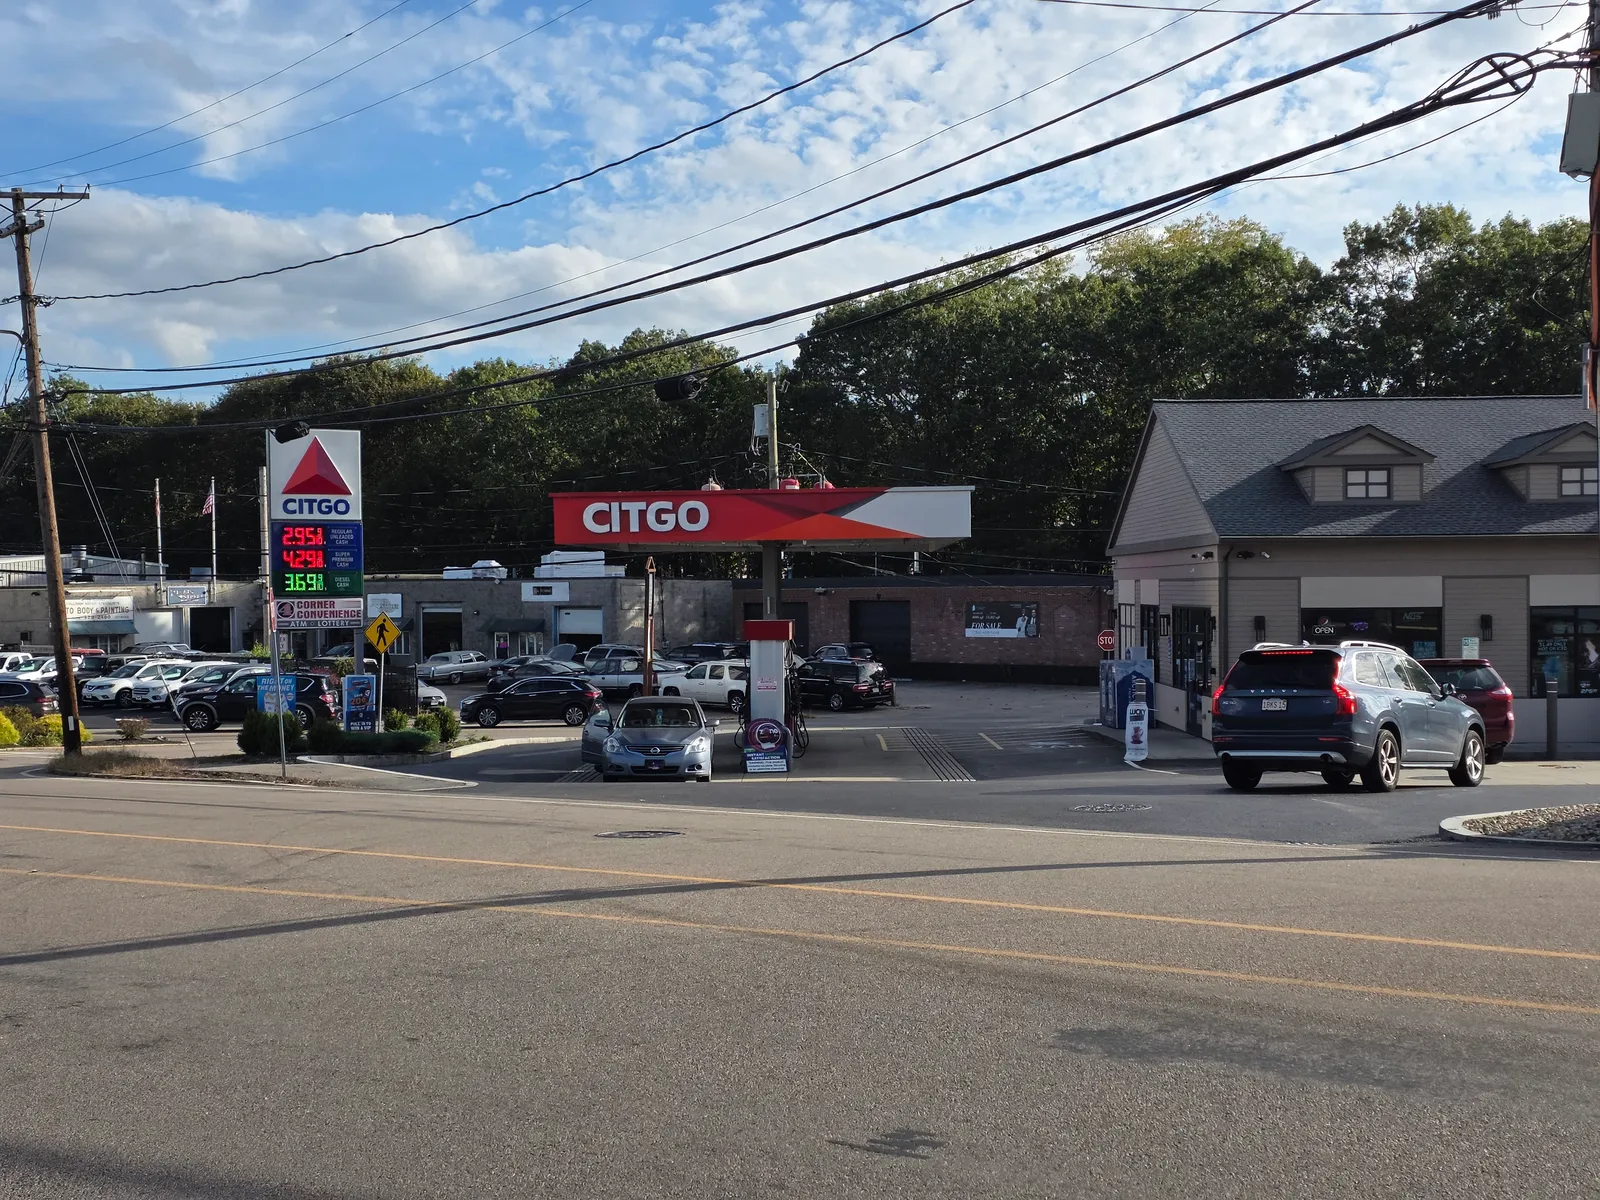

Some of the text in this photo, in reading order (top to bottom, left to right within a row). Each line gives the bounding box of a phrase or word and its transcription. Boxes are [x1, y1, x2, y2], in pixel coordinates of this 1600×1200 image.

[282, 498, 350, 515] CITGO
[582, 500, 709, 533] CITGO
[296, 600, 335, 609] CORNER
[77, 606, 93, 615] BODY
[100, 606, 130, 615] PAINTING
[296, 609, 362, 619] CONVENIENCE
[1314, 626, 1335, 634] OPEN
[1129, 708, 1147, 716] LUCKY
